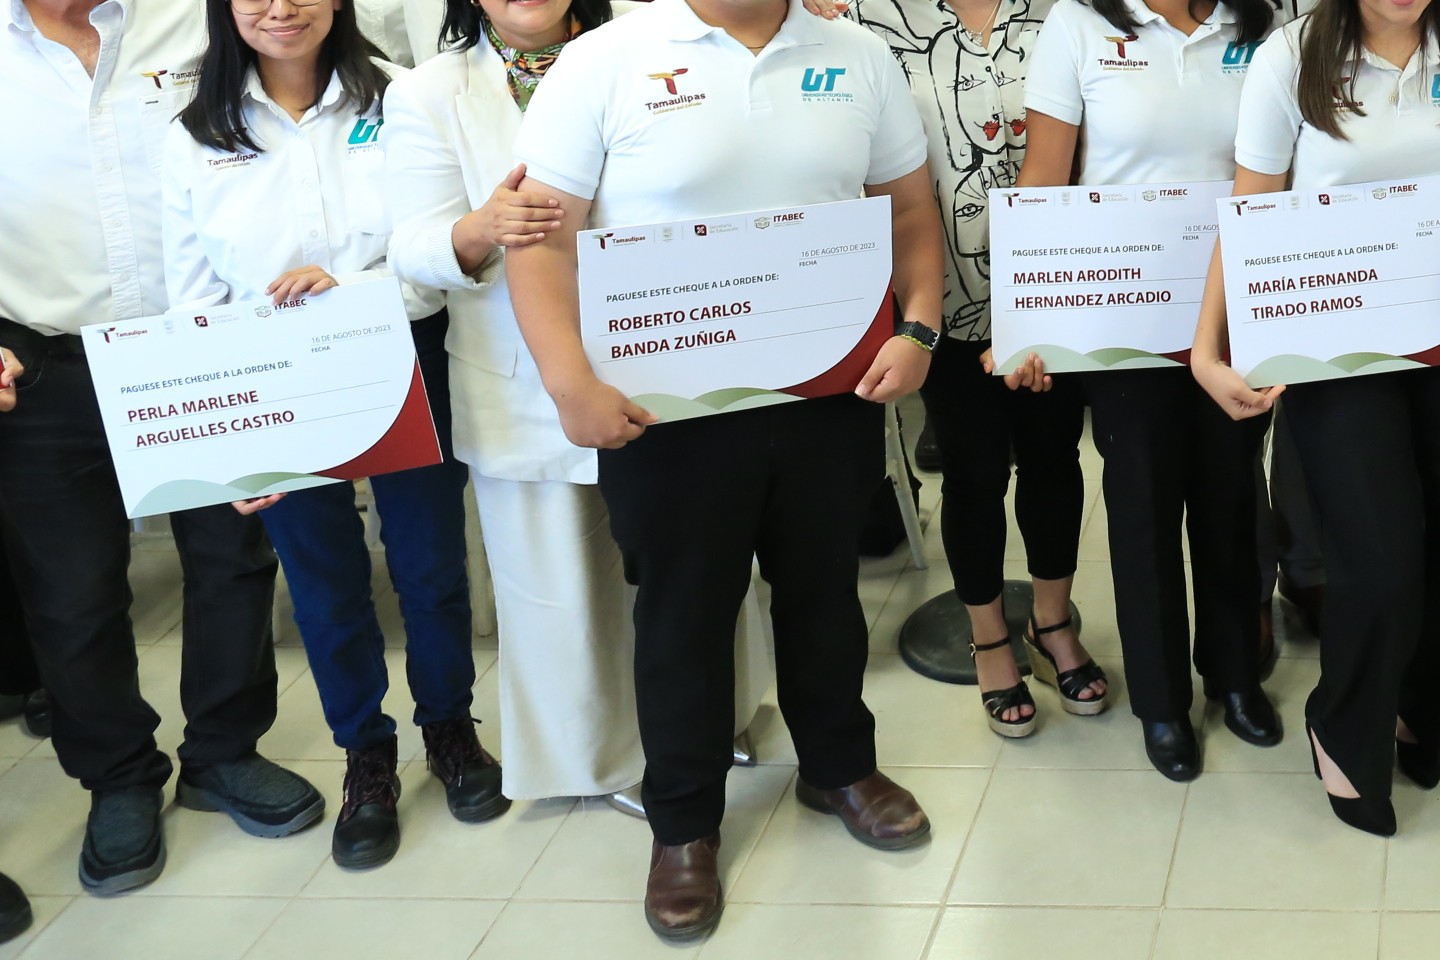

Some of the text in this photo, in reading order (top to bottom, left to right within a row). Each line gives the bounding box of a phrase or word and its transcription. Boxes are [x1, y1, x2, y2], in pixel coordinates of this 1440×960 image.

[1098, 59, 1148, 67] Tamaulipas
[801, 68, 846, 91] UT
[645, 93, 706, 110] Tamaulipas
[207, 152, 258, 166] Tamaulipas
[1159, 188, 1188, 197] ITABEC
[1389, 184, 1418, 194] ITABEC
[773, 212, 804, 222] ITABEC
[612, 235, 646, 244] Tamaulipas
[821, 246, 848, 255] AGOSTO
[860, 242, 876, 250] 2023
[1012, 249, 1048, 257] PAGUESE
[1050, 248, 1068, 256] ESTE
[1070, 247, 1102, 255] CHEQUE
[1122, 245, 1150, 253] ORDEN
[1245, 256, 1281, 266] PAGUESE
[1283, 253, 1301, 262] ESTE
[1303, 250, 1336, 260] CHEQUE
[1356, 244, 1384, 254] ORDEN
[1386, 242, 1399, 250] DE:
[1013, 268, 1141, 284] MARLEN ARODITH
[1248, 268, 1378, 295] MARÍA FERNANDA
[606, 290, 648, 303] PAGUESE
[650, 287, 671, 297] ESTE
[673, 282, 710, 294] CHEQUE
[732, 274, 764, 286] ORDEN
[765, 273, 779, 282] DE:
[274, 298, 307, 310] ITABEC
[1015, 290, 1171, 309] HERNANDEZ ARCADIO
[1251, 296, 1363, 320] TIRADO RAMOS
[608, 301, 752, 332] ROBERTO CARLOS
[115, 329, 148, 338] Tamaulipas
[311, 336, 320, 344] 16
[332, 329, 362, 340] AGOSTO
[374, 324, 391, 333] 2023
[611, 329, 737, 359] BANDA ZUÑIGA
[120, 382, 161, 394] PAGUESE
[162, 378, 183, 388] ESTE
[185, 372, 222, 385] CHEQUE
[231, 368, 243, 377] LA
[244, 363, 276, 375] ORDEN
[278, 360, 292, 369] DE:
[128, 390, 259, 422] PERLA MARLENE
[136, 410, 295, 448] ARGUELLES CASTRO
